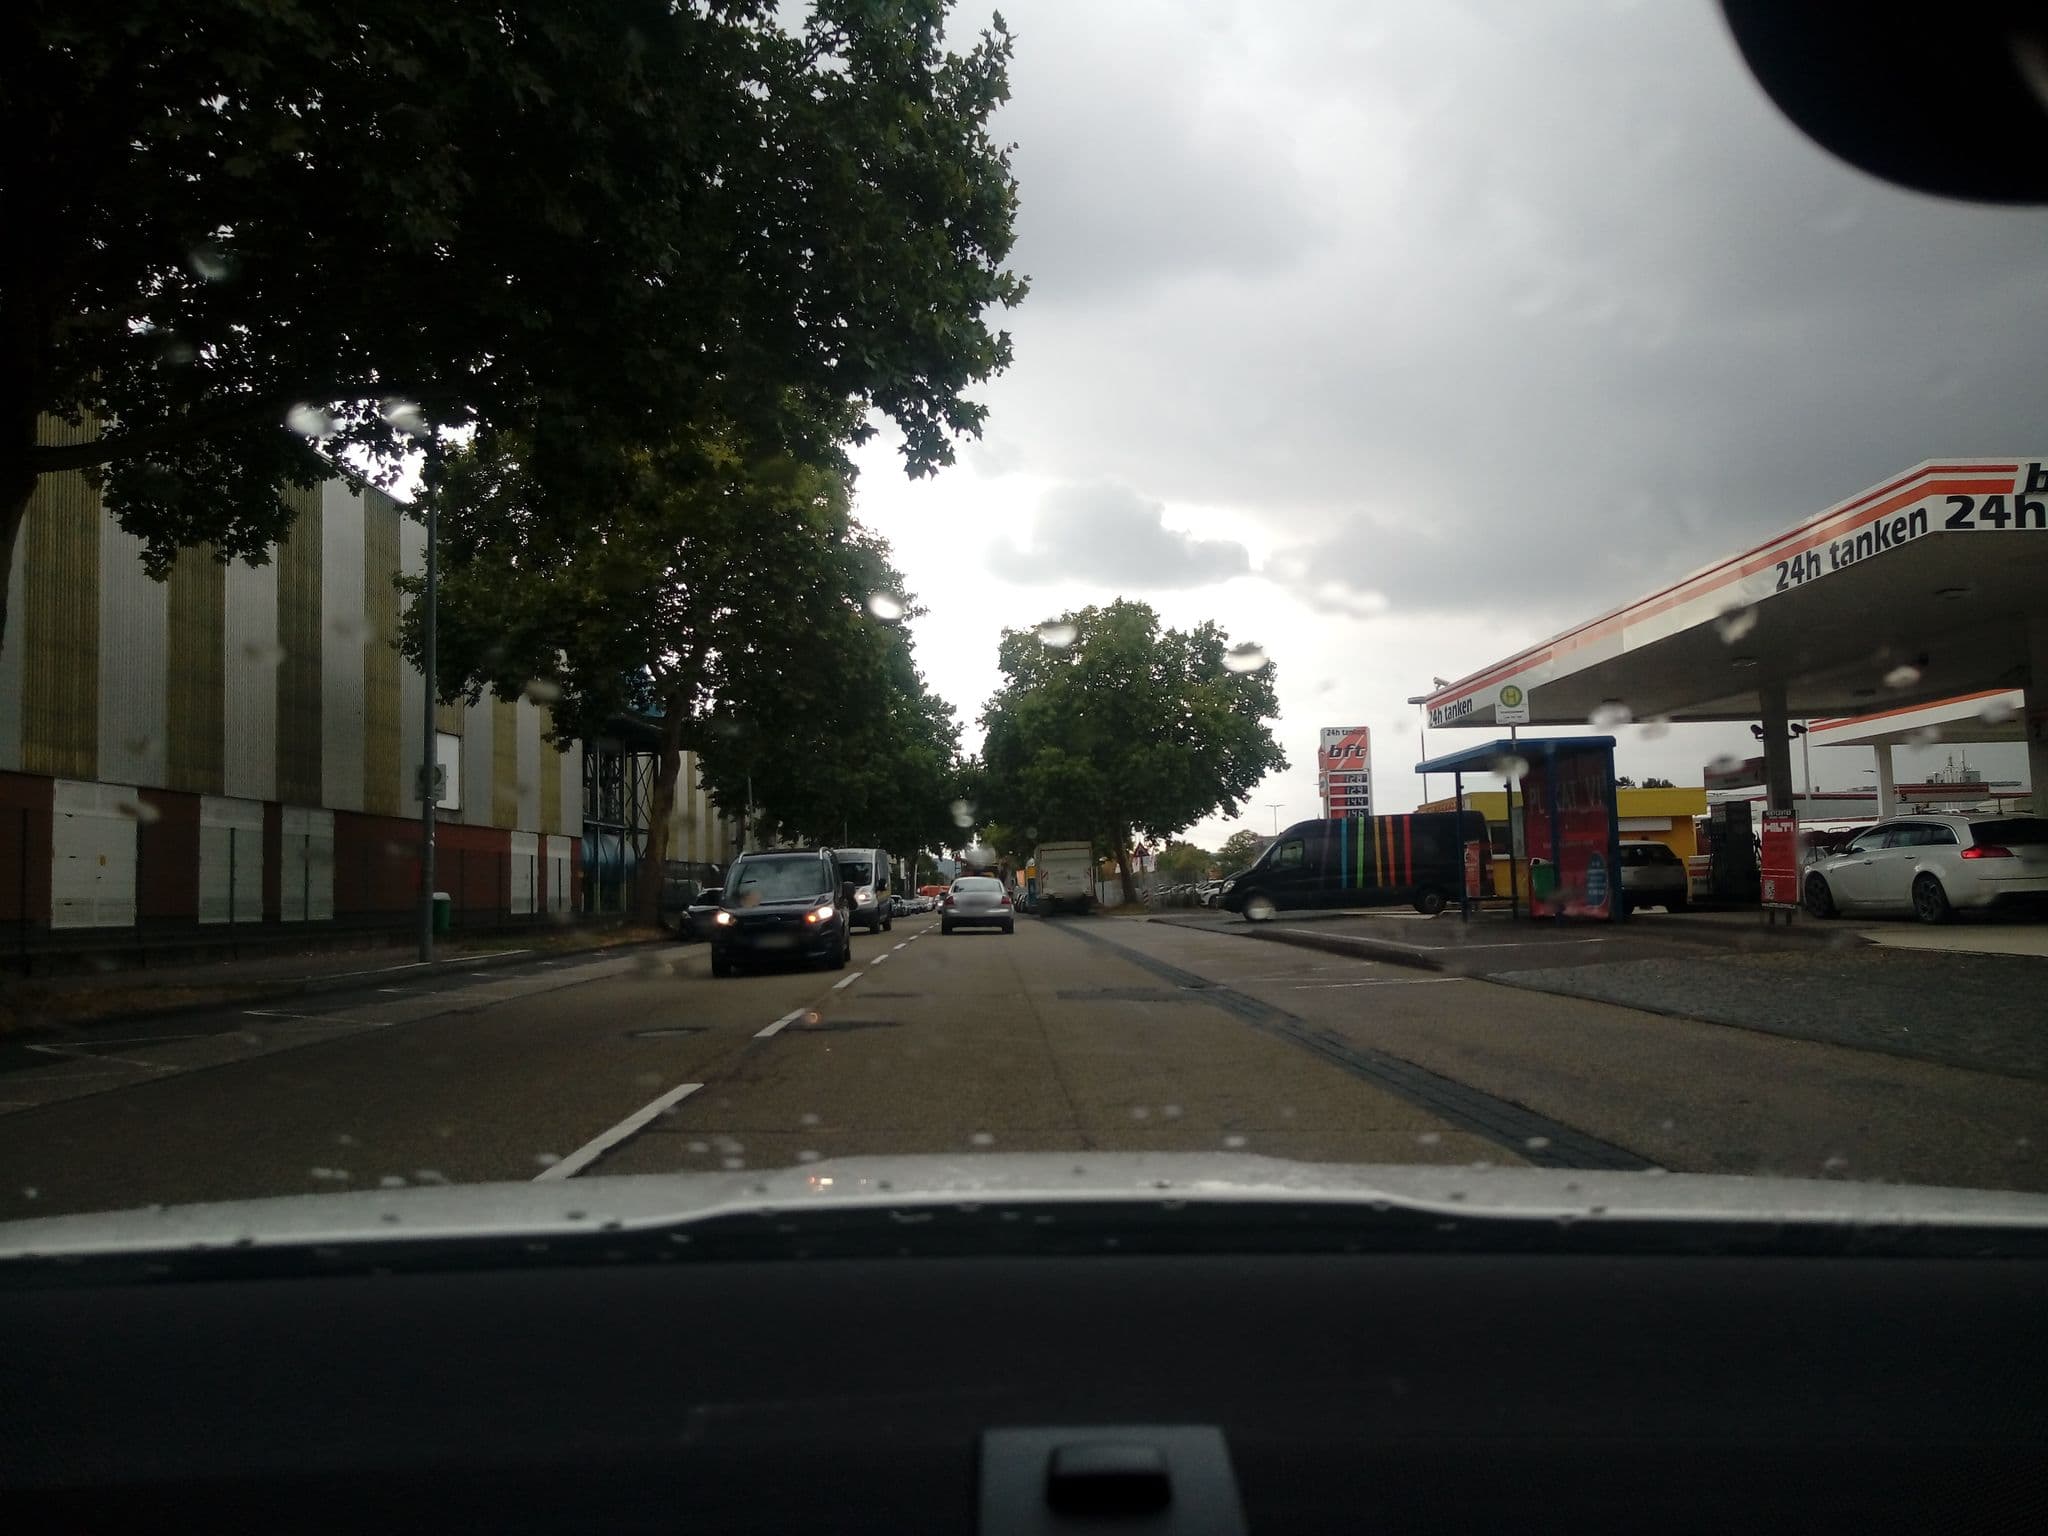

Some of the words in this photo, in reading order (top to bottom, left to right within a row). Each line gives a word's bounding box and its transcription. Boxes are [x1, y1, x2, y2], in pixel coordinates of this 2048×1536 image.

[1945, 495, 2046, 529] 24h
[1776, 551, 1821, 592] 24h
[1829, 507, 1927, 570] tanken
[1444, 697, 1472, 720] tanken
[1329, 744, 1366, 759] bft
[1764, 822, 1793, 833] HILTI
